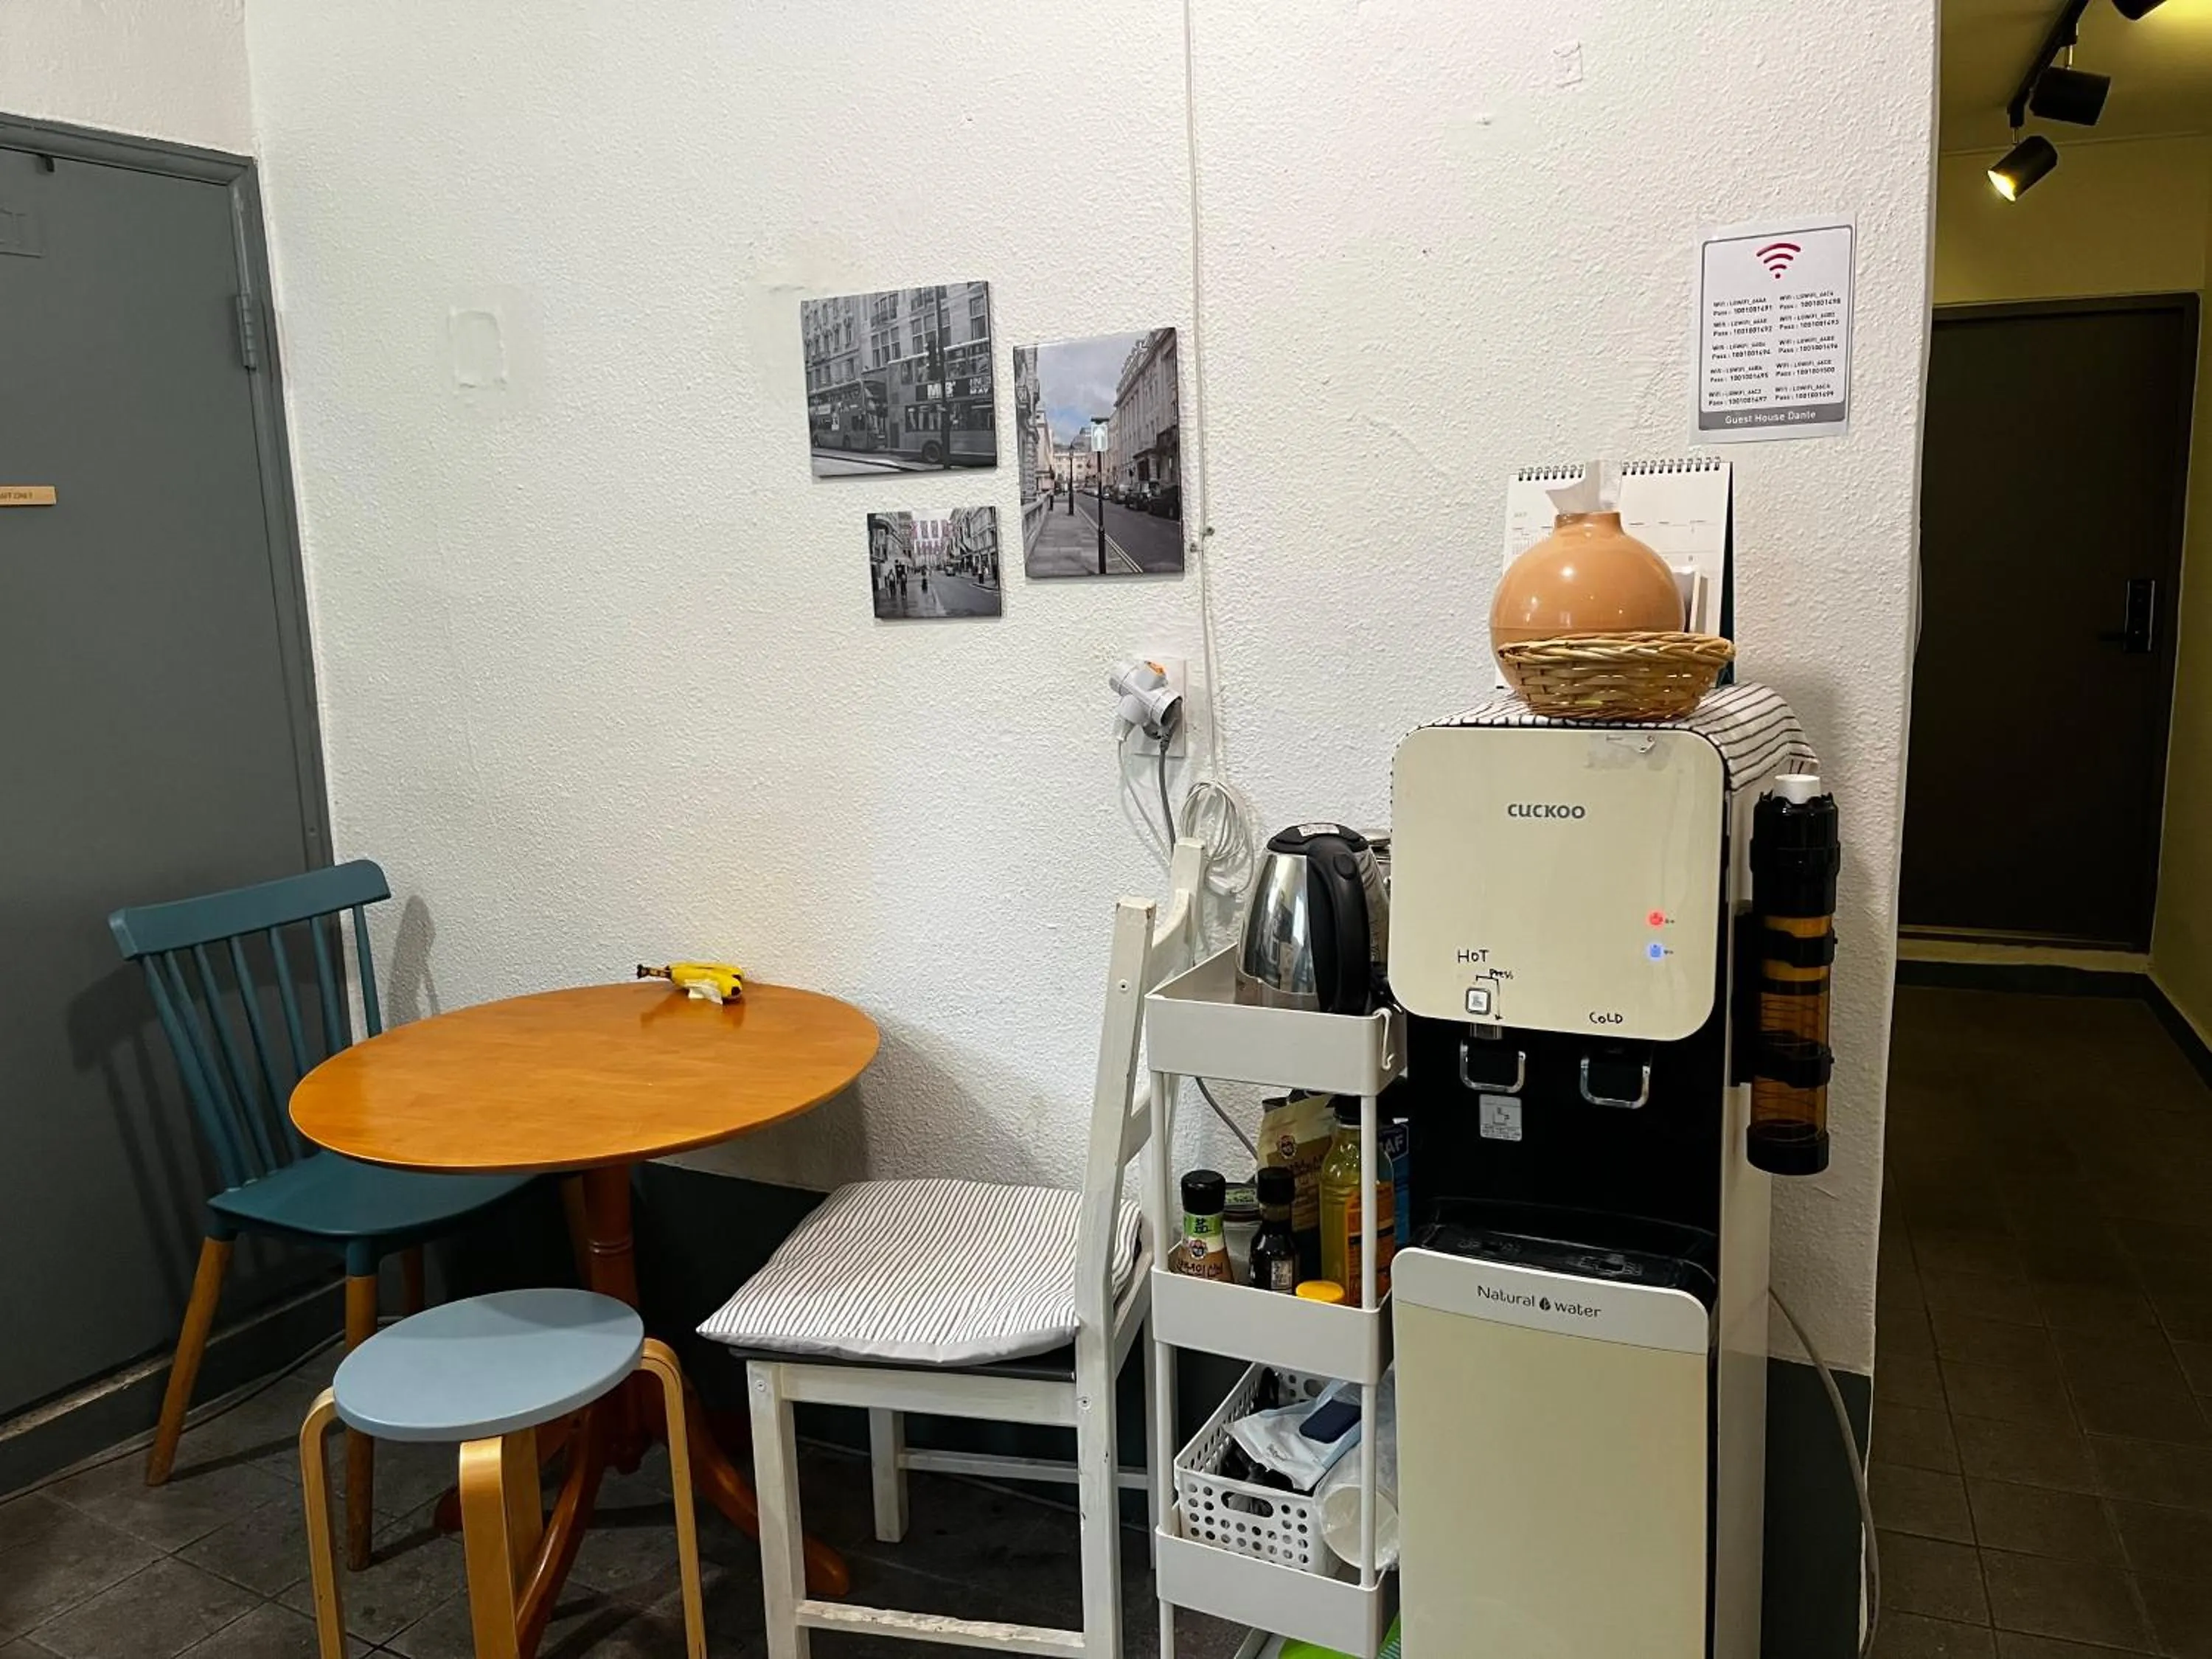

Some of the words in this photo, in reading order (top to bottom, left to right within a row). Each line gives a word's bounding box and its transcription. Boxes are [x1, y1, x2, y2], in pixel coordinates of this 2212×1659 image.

[1725, 414, 1753, 425] Guest
[1754, 411, 1786, 423] House
[1507, 802, 1586, 820] CUCKOO
[1458, 948, 1489, 963] HOT
[1589, 1011, 1623, 1024] COLD
[1477, 1285, 1535, 1307] Natural
[1554, 1301, 1601, 1318] water
